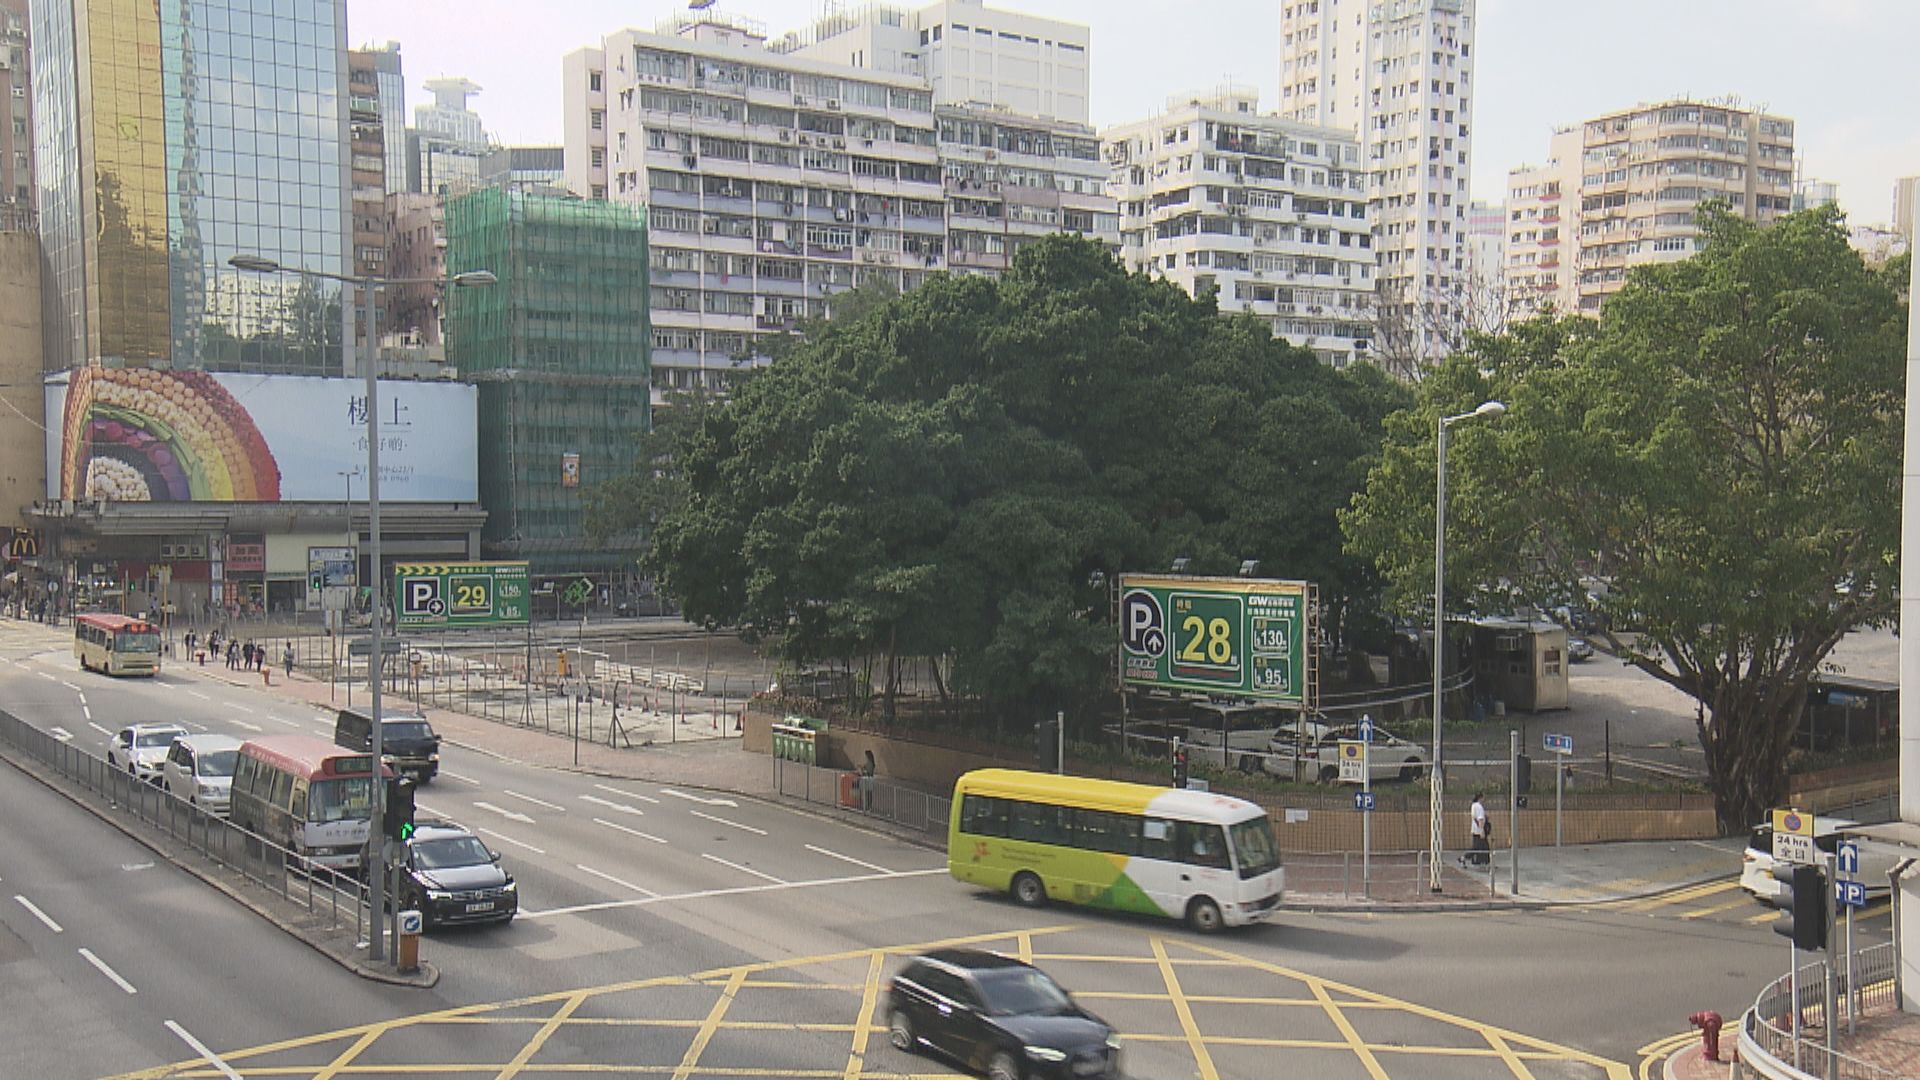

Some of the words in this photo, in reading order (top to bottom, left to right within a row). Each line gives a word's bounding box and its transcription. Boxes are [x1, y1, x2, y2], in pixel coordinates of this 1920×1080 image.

[412, 583, 433, 610] P
[457, 585, 486, 607] 29
[1130, 602, 1153, 642] P
[1182, 615, 1232, 664] 28
[1364, 796, 1372, 807] P
[1777, 836, 1790, 846] 24
[1792, 836, 1809, 848] hrs
[1780, 847, 1805, 861] 全日
[1848, 887, 1860, 902] P
